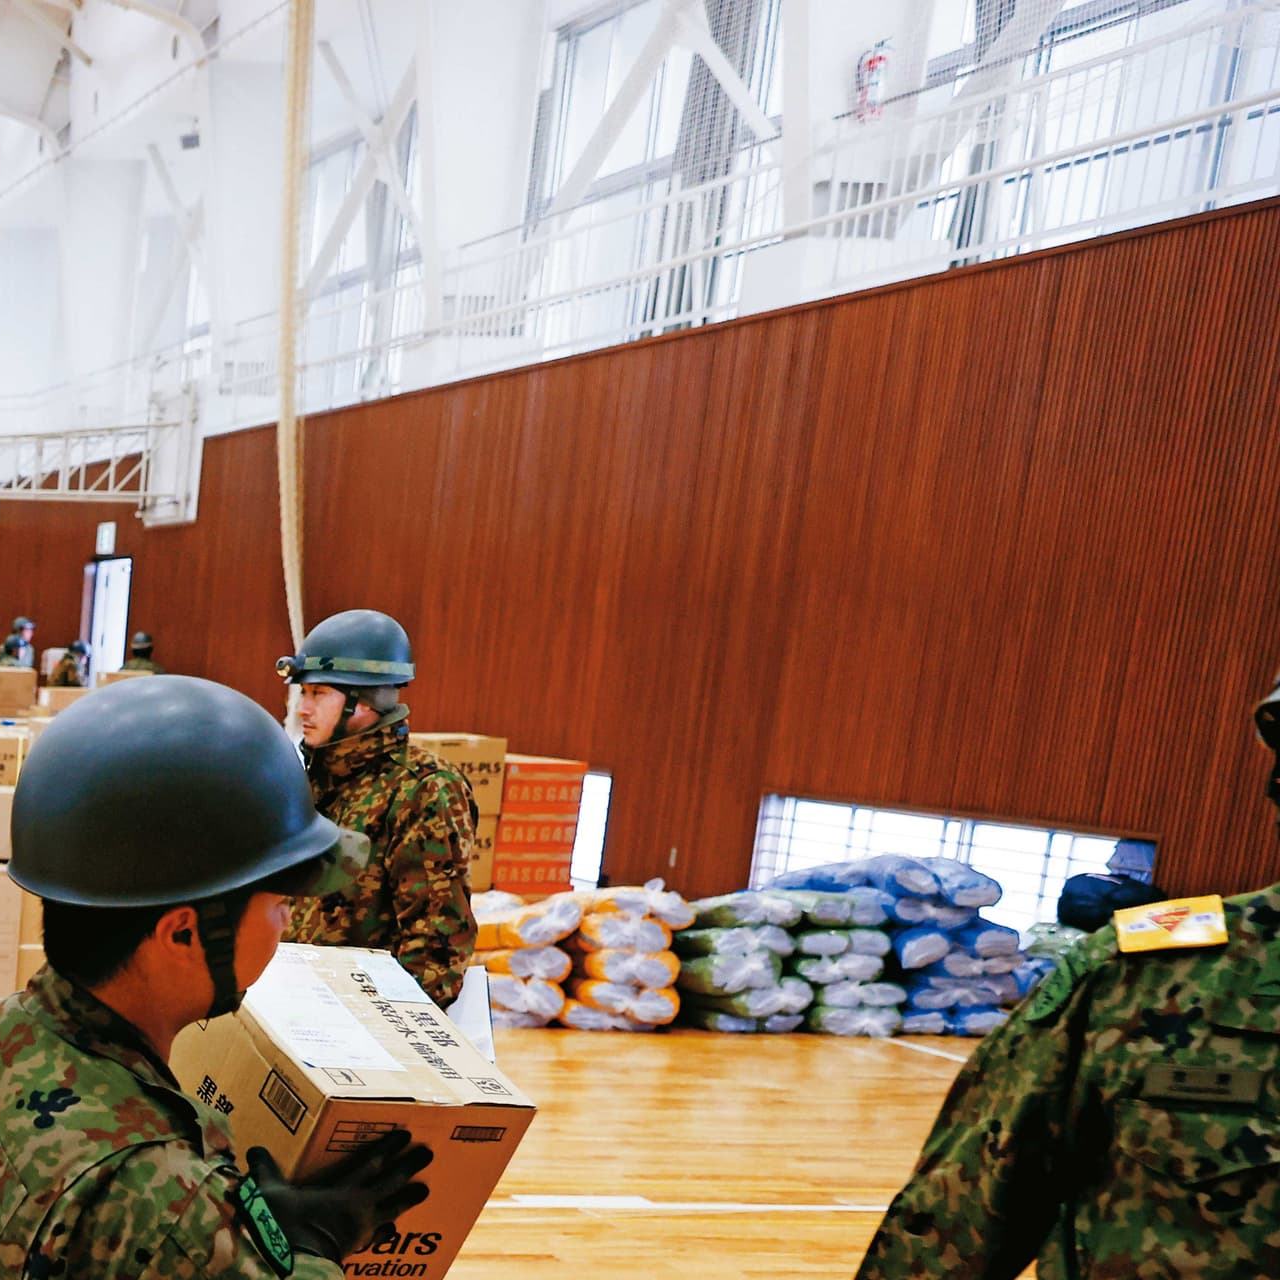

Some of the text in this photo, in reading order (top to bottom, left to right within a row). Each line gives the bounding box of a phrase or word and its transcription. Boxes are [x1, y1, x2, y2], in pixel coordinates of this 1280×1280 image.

[406, 1012, 459, 1047] 黒部
[354, 1231, 443, 1256] ars
[342, 1258, 428, 1278] rvation
